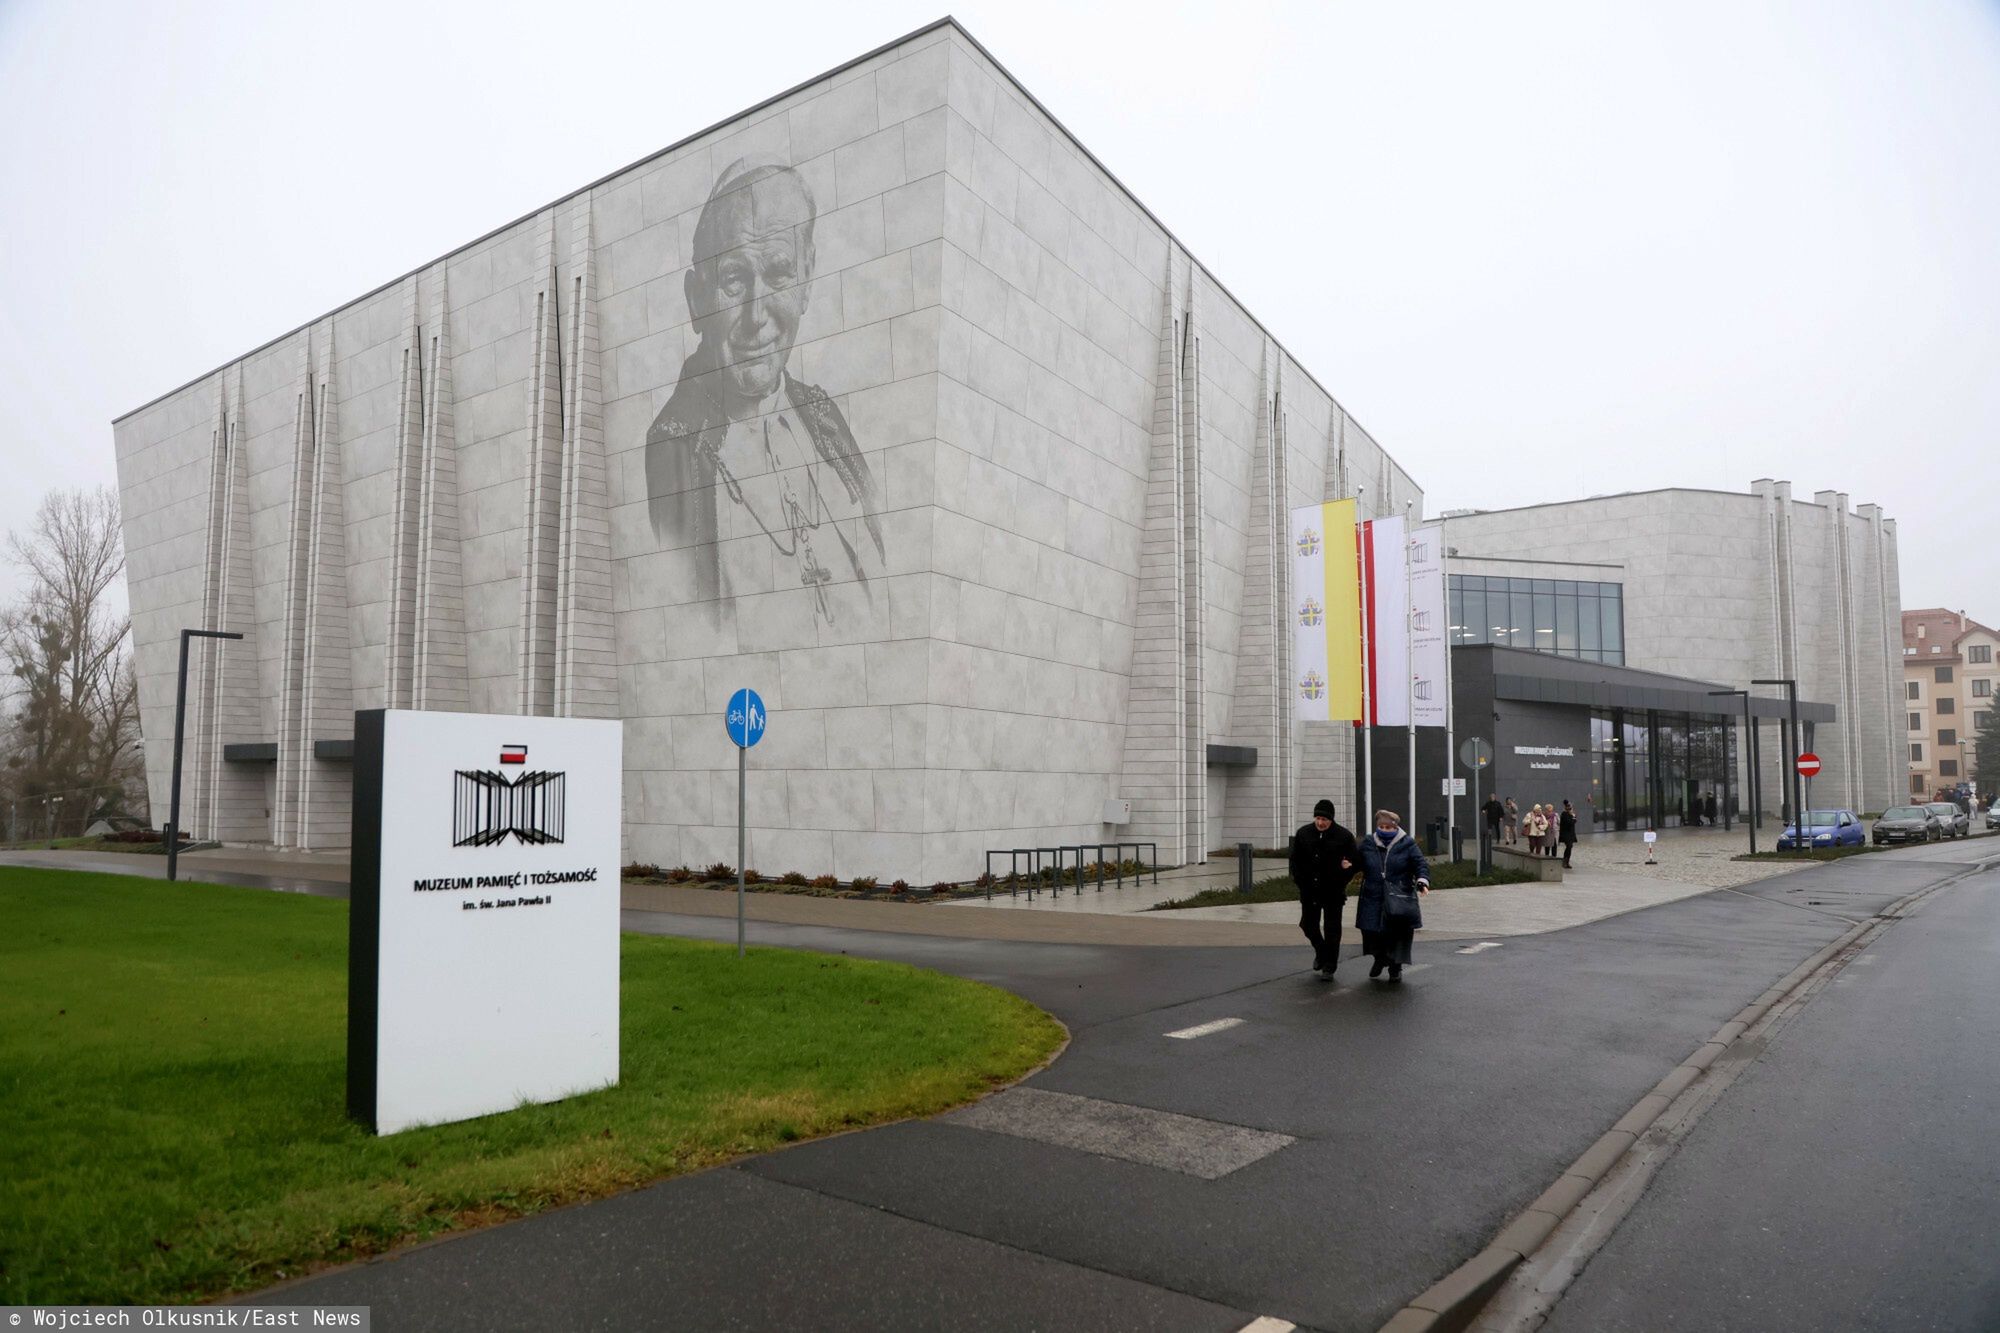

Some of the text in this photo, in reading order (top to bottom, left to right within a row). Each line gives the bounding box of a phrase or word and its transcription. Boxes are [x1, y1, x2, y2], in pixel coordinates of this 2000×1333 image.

[414, 868, 597, 891] MUZEUM PAMIĘĆ I TOŻSAMOŚĆ
[462, 895, 552, 911] im. św. Jana Pawła II
